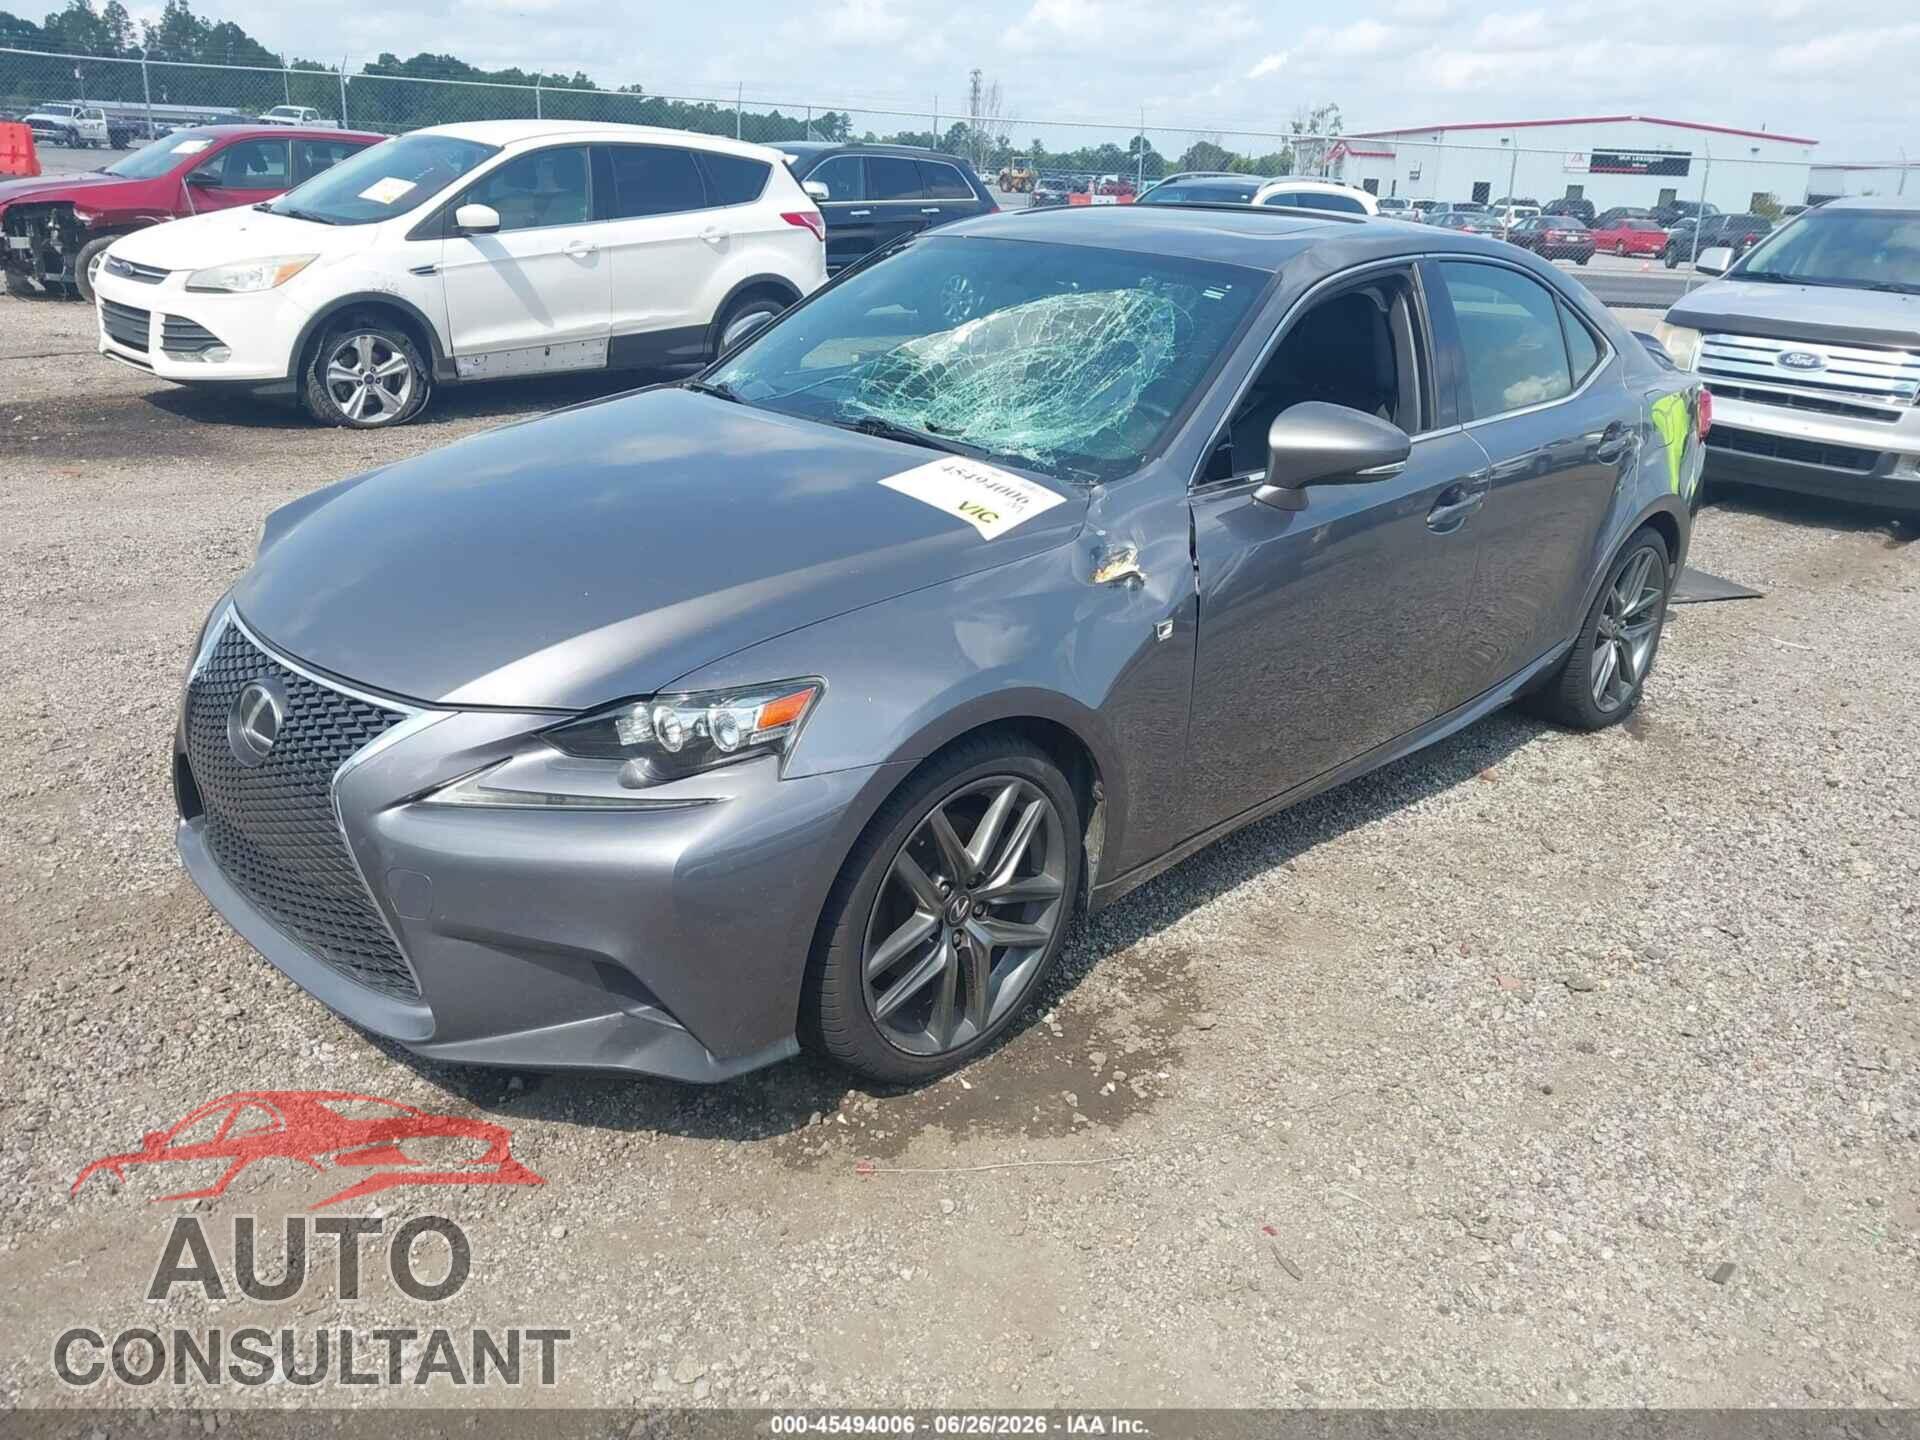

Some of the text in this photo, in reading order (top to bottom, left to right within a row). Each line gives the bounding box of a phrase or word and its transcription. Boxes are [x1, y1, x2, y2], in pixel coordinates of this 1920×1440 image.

[1786, 354, 1815, 366] Ford
[942, 465, 1029, 504] 45494006
[958, 500, 999, 523] VIC
